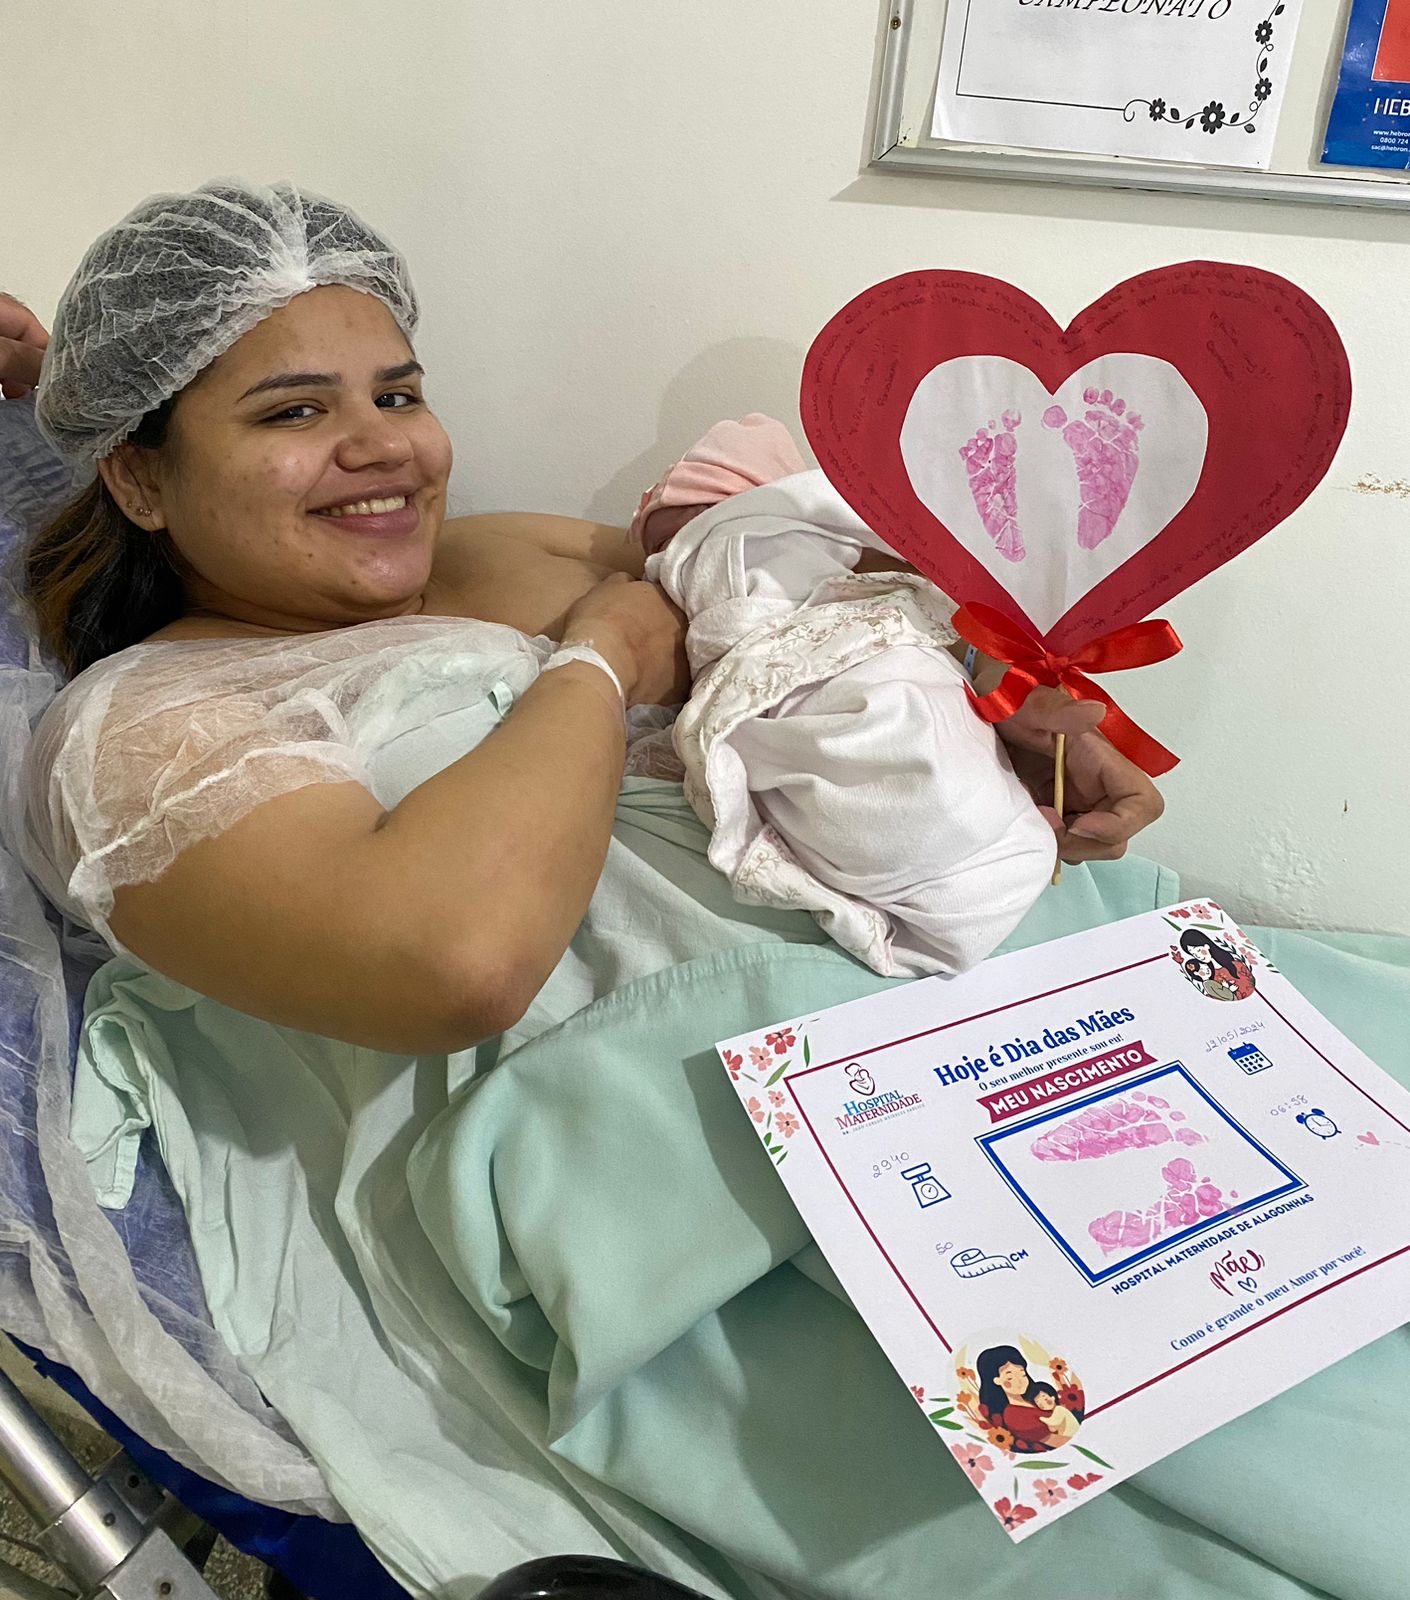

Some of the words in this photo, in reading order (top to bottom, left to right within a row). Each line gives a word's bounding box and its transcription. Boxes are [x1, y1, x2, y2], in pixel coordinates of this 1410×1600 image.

[1379, 136, 1396, 144] 0800
[933, 1056, 989, 1087] Hoje
[988, 1045, 1005, 1068] é
[1001, 1037, 1043, 1063] Dia
[1042, 1025, 1081, 1049] das
[1076, 1008, 1135, 1037] Mães
[978, 1082, 988, 1092] O
[990, 1076, 1008, 1089] seu
[1009, 1062, 1045, 1083] melhor
[1045, 1047, 1089, 1070] presente
[1089, 1041, 1108, 1054] sou
[1107, 1033, 1124, 1048] eu!
[843, 1090, 903, 1116] HOSPITAL
[989, 1090, 1030, 1115] MEU
[1031, 1049, 1143, 1100] NASCIMENTO
[834, 1093, 922, 1130] MATERNIDADE
[872, 1151, 910, 1179] 2940
[935, 1241, 954, 1256] 50
[1009, 1249, 1029, 1263] CM
[1111, 1264, 1167, 1295] HOSPITAL
[1165, 1226, 1239, 1268] MATERNIDADE
[1236, 1220, 1253, 1233] DE
[1252, 1193, 1315, 1227] ALAGOINHAS
[1210, 1249, 1263, 1297] Mãe
[1170, 1329, 1206, 1351] Como
[1205, 1322, 1216, 1334] é
[1215, 1300, 1257, 1331] grande
[1255, 1297, 1265, 1307] o
[1264, 1285, 1290, 1302] meu
[1289, 1269, 1320, 1290] Amor
[1318, 1260, 1339, 1277] por
[1337, 1245, 1367, 1264] você!
